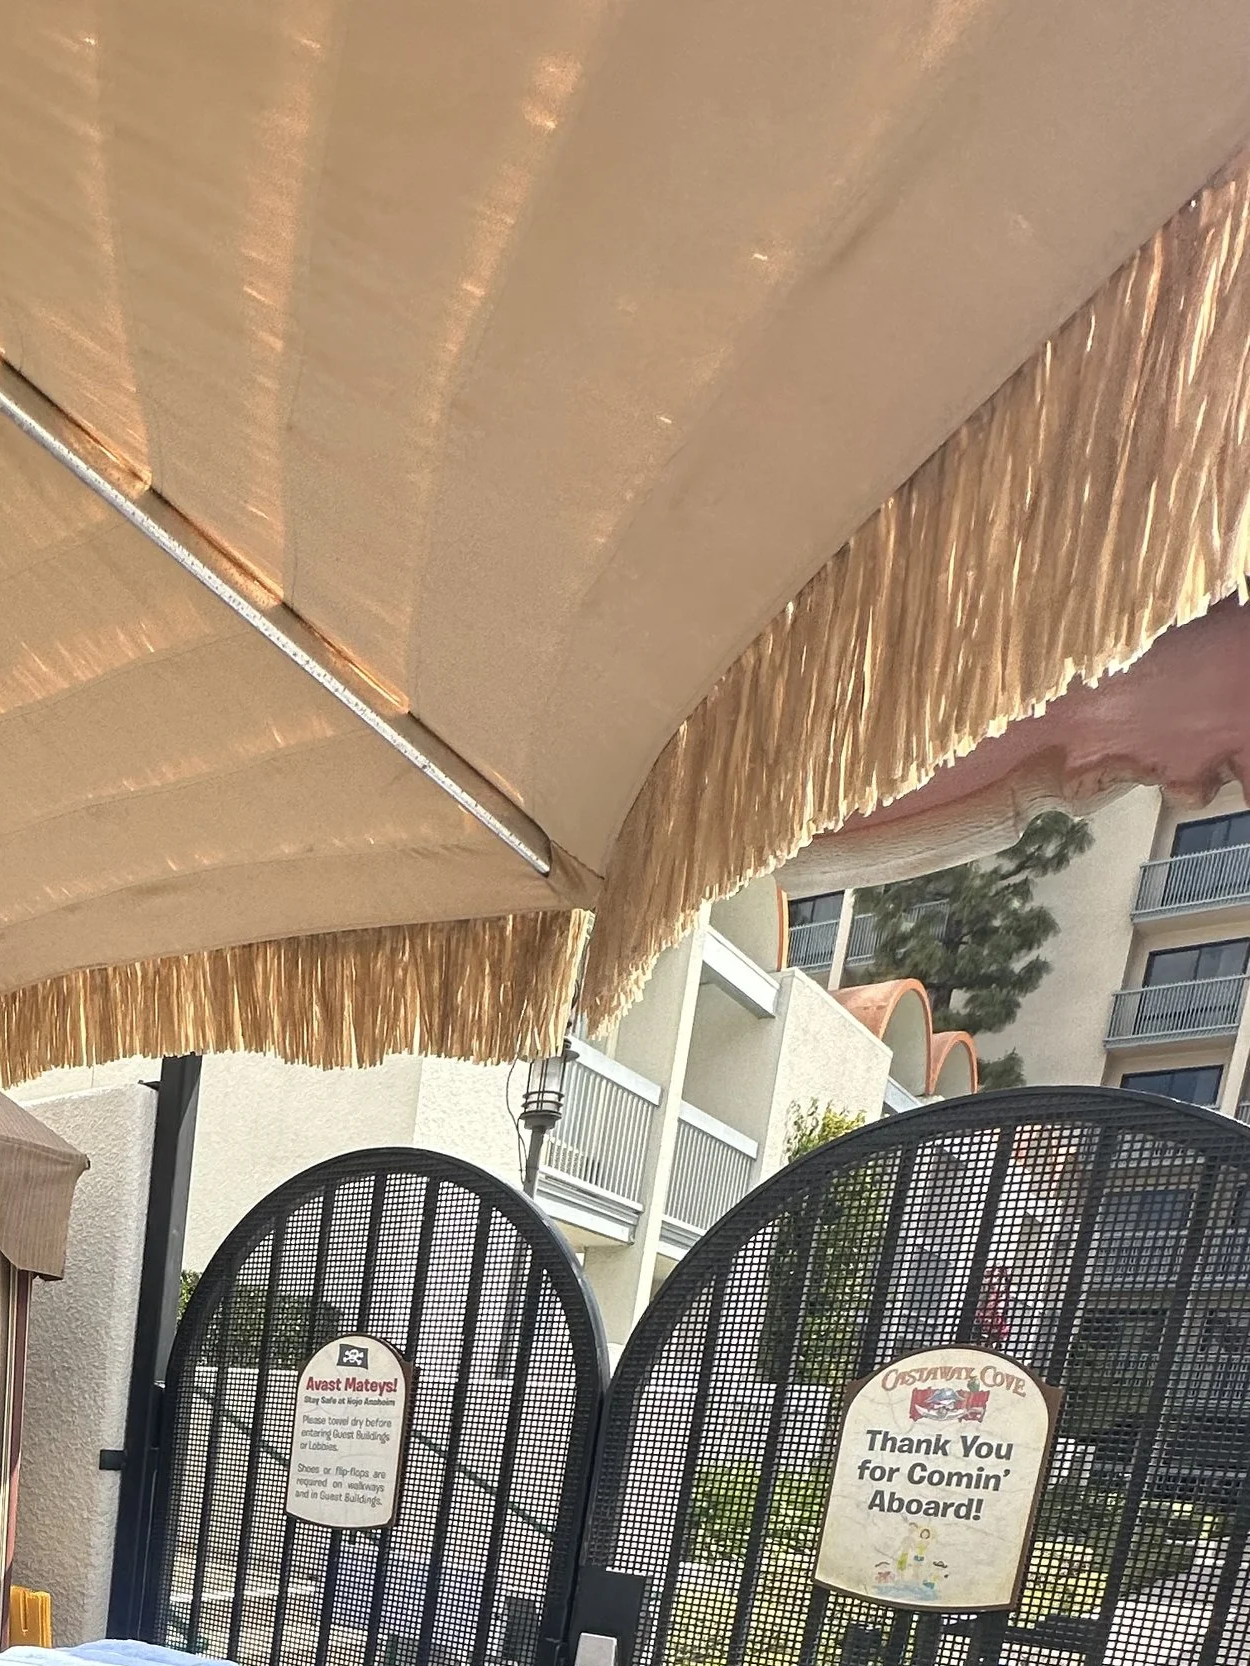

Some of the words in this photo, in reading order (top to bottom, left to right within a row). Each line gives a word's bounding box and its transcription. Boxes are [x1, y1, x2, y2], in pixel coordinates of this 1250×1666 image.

[306, 1376, 342, 1391] Avast
[344, 1377, 398, 1396] Mateys!
[881, 1366, 978, 1391] CASTAWAY
[980, 1365, 1027, 1398] COVE
[304, 1395, 320, 1406] Stay
[321, 1396, 337, 1405] Safe
[338, 1397, 346, 1405] at
[302, 1415, 326, 1425] Please
[328, 1415, 349, 1425] towel
[351, 1416, 363, 1428] dry
[365, 1417, 392, 1428] before
[301, 1428, 331, 1440] entering
[332, 1429, 355, 1440] Guest
[356, 1430, 390, 1444] Buildings
[308, 1440, 338, 1451] Lobbies.
[865, 1429, 951, 1456] Thank
[960, 1434, 1014, 1461] You
[297, 1463, 320, 1474] Shoes
[323, 1466, 332, 1474] or
[335, 1466, 369, 1479] flip-flops
[372, 1470, 386, 1479] are
[857, 1460, 900, 1482] for
[907, 1462, 1011, 1492] Comin'
[296, 1478, 327, 1488] required
[347, 1481, 385, 1494] walkways
[295, 1490, 309, 1498] and
[310, 1490, 318, 1499] in
[319, 1490, 342, 1501] Guest
[344, 1492, 383, 1508] Buildings.
[867, 1489, 985, 1521] Aboard!
